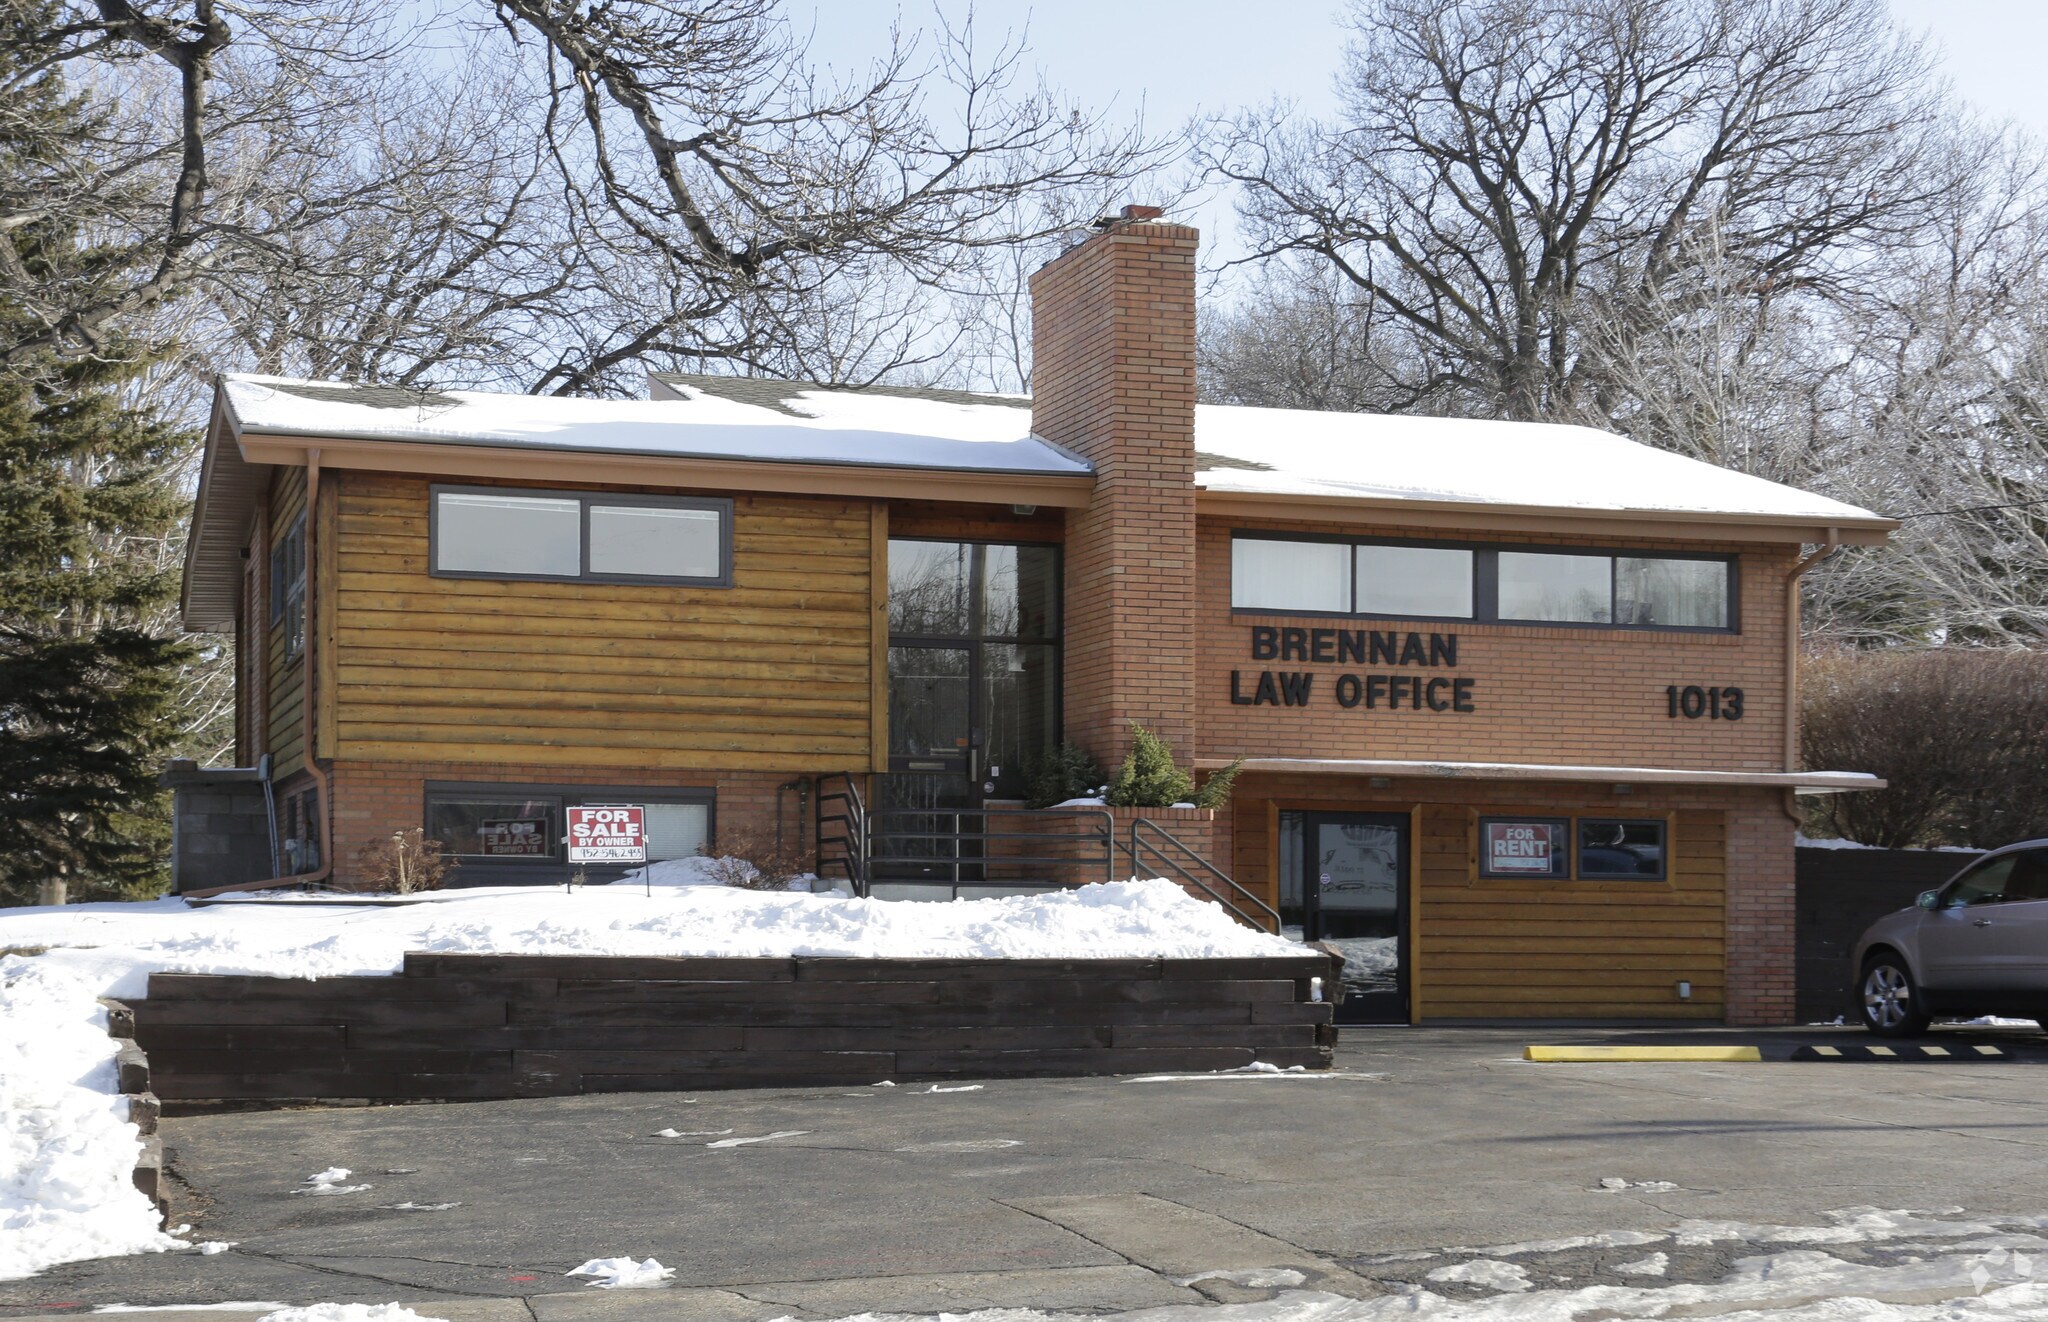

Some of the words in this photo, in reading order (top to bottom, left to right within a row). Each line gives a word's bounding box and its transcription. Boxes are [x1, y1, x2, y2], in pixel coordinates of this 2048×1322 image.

[1250, 625, 1458, 667] BRENNAN
[1230, 670, 1313, 707] LAW
[1336, 673, 1475, 713] OFFICE
[1665, 684, 1744, 721] 1013
[581, 810, 630, 823] FOR
[572, 823, 640, 838] SALE
[1506, 828, 1534, 840] FOR
[579, 837, 594, 846] BY
[596, 837, 634, 846] OWNER
[1494, 840, 1547, 857] RENT
